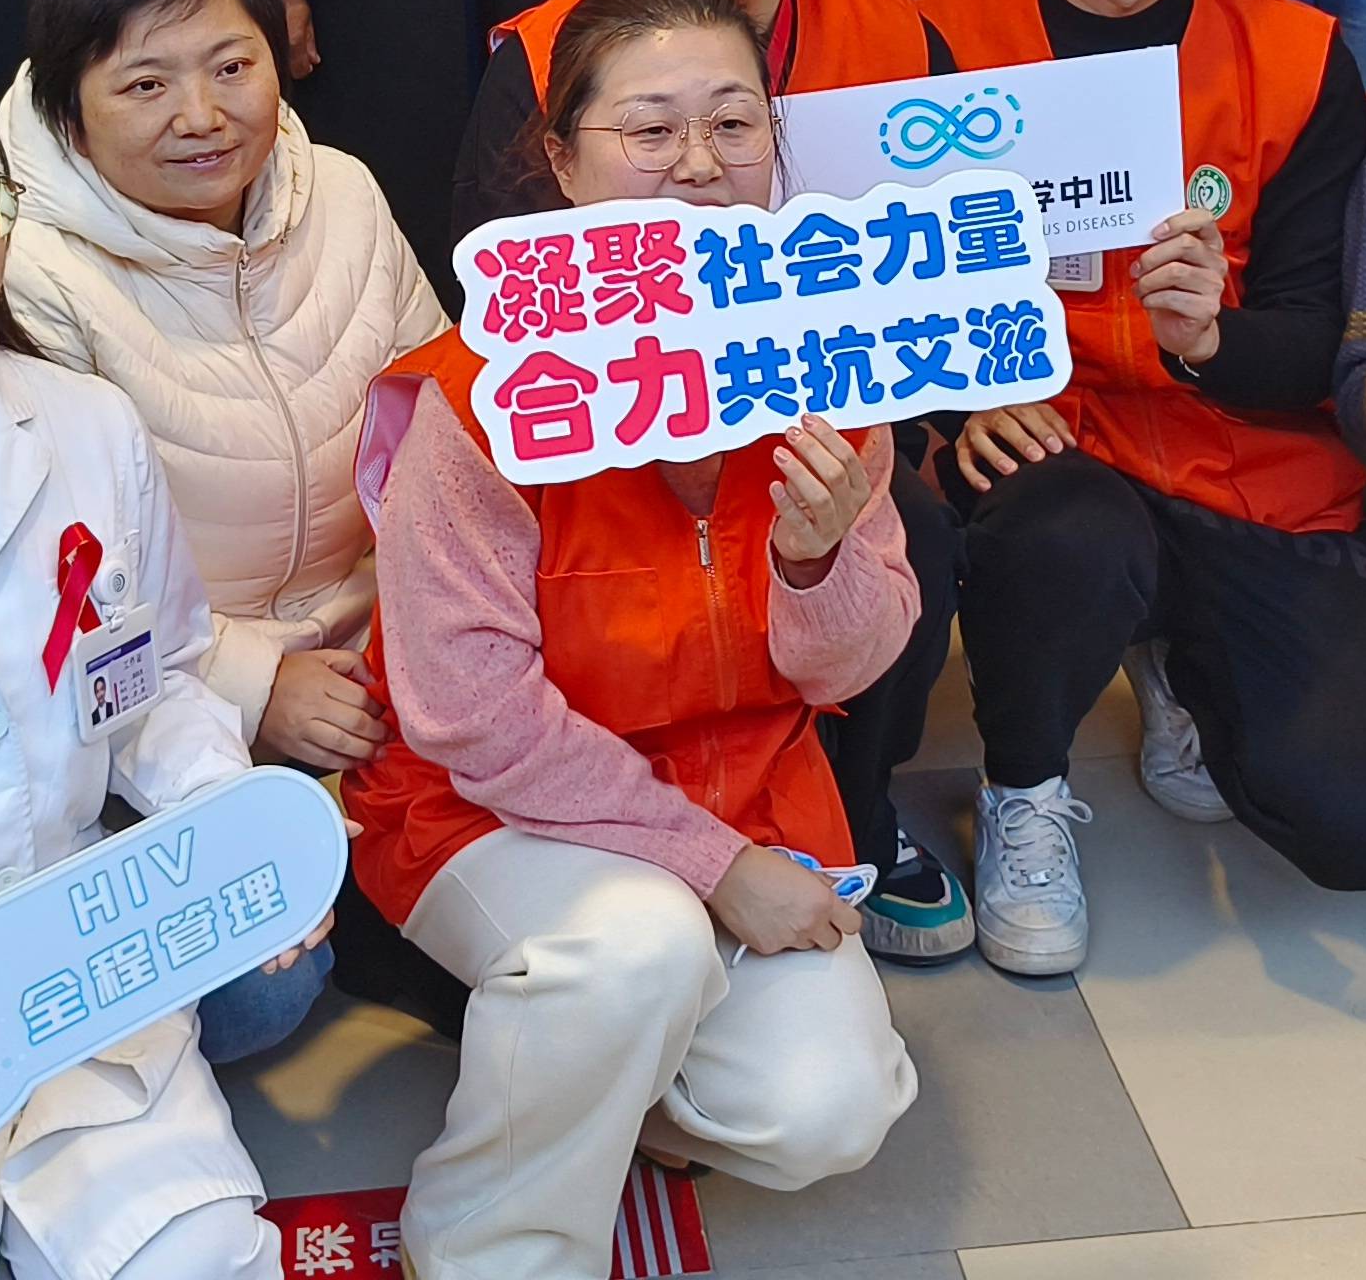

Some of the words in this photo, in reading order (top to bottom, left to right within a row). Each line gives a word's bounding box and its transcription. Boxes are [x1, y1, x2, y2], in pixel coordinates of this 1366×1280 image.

[474, 189, 1032, 344] 凝聚社会力量
[1066, 212, 1136, 233] DISEASES
[492, 299, 1056, 462] 合力共抗艾滋
[19, 861, 289, 1046] 全程管理
[69, 826, 195, 936] HIV
